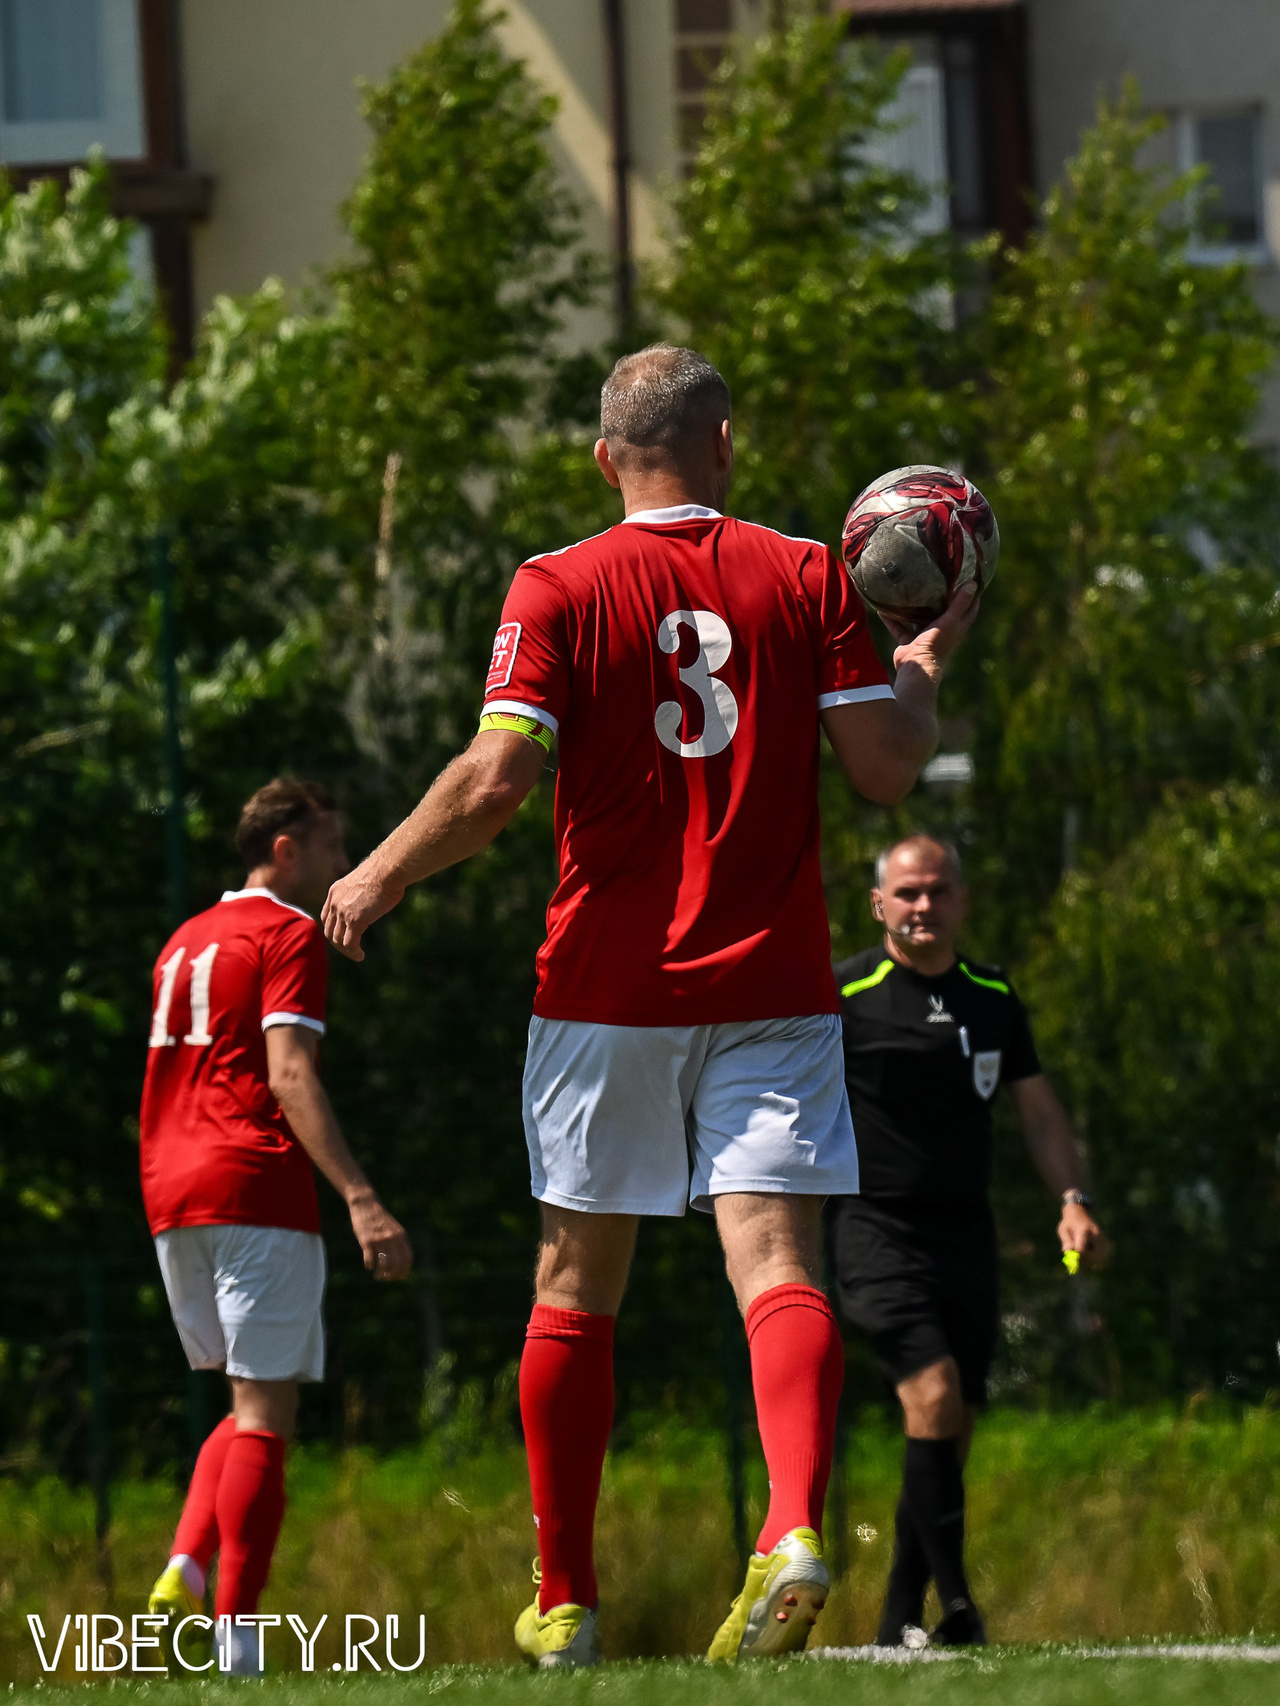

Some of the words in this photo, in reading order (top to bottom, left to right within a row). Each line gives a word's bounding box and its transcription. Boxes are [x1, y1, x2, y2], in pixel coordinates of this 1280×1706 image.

[492, 631, 512, 650] ON
[654, 609, 739, 758] 3
[148, 942, 220, 1047] 11
